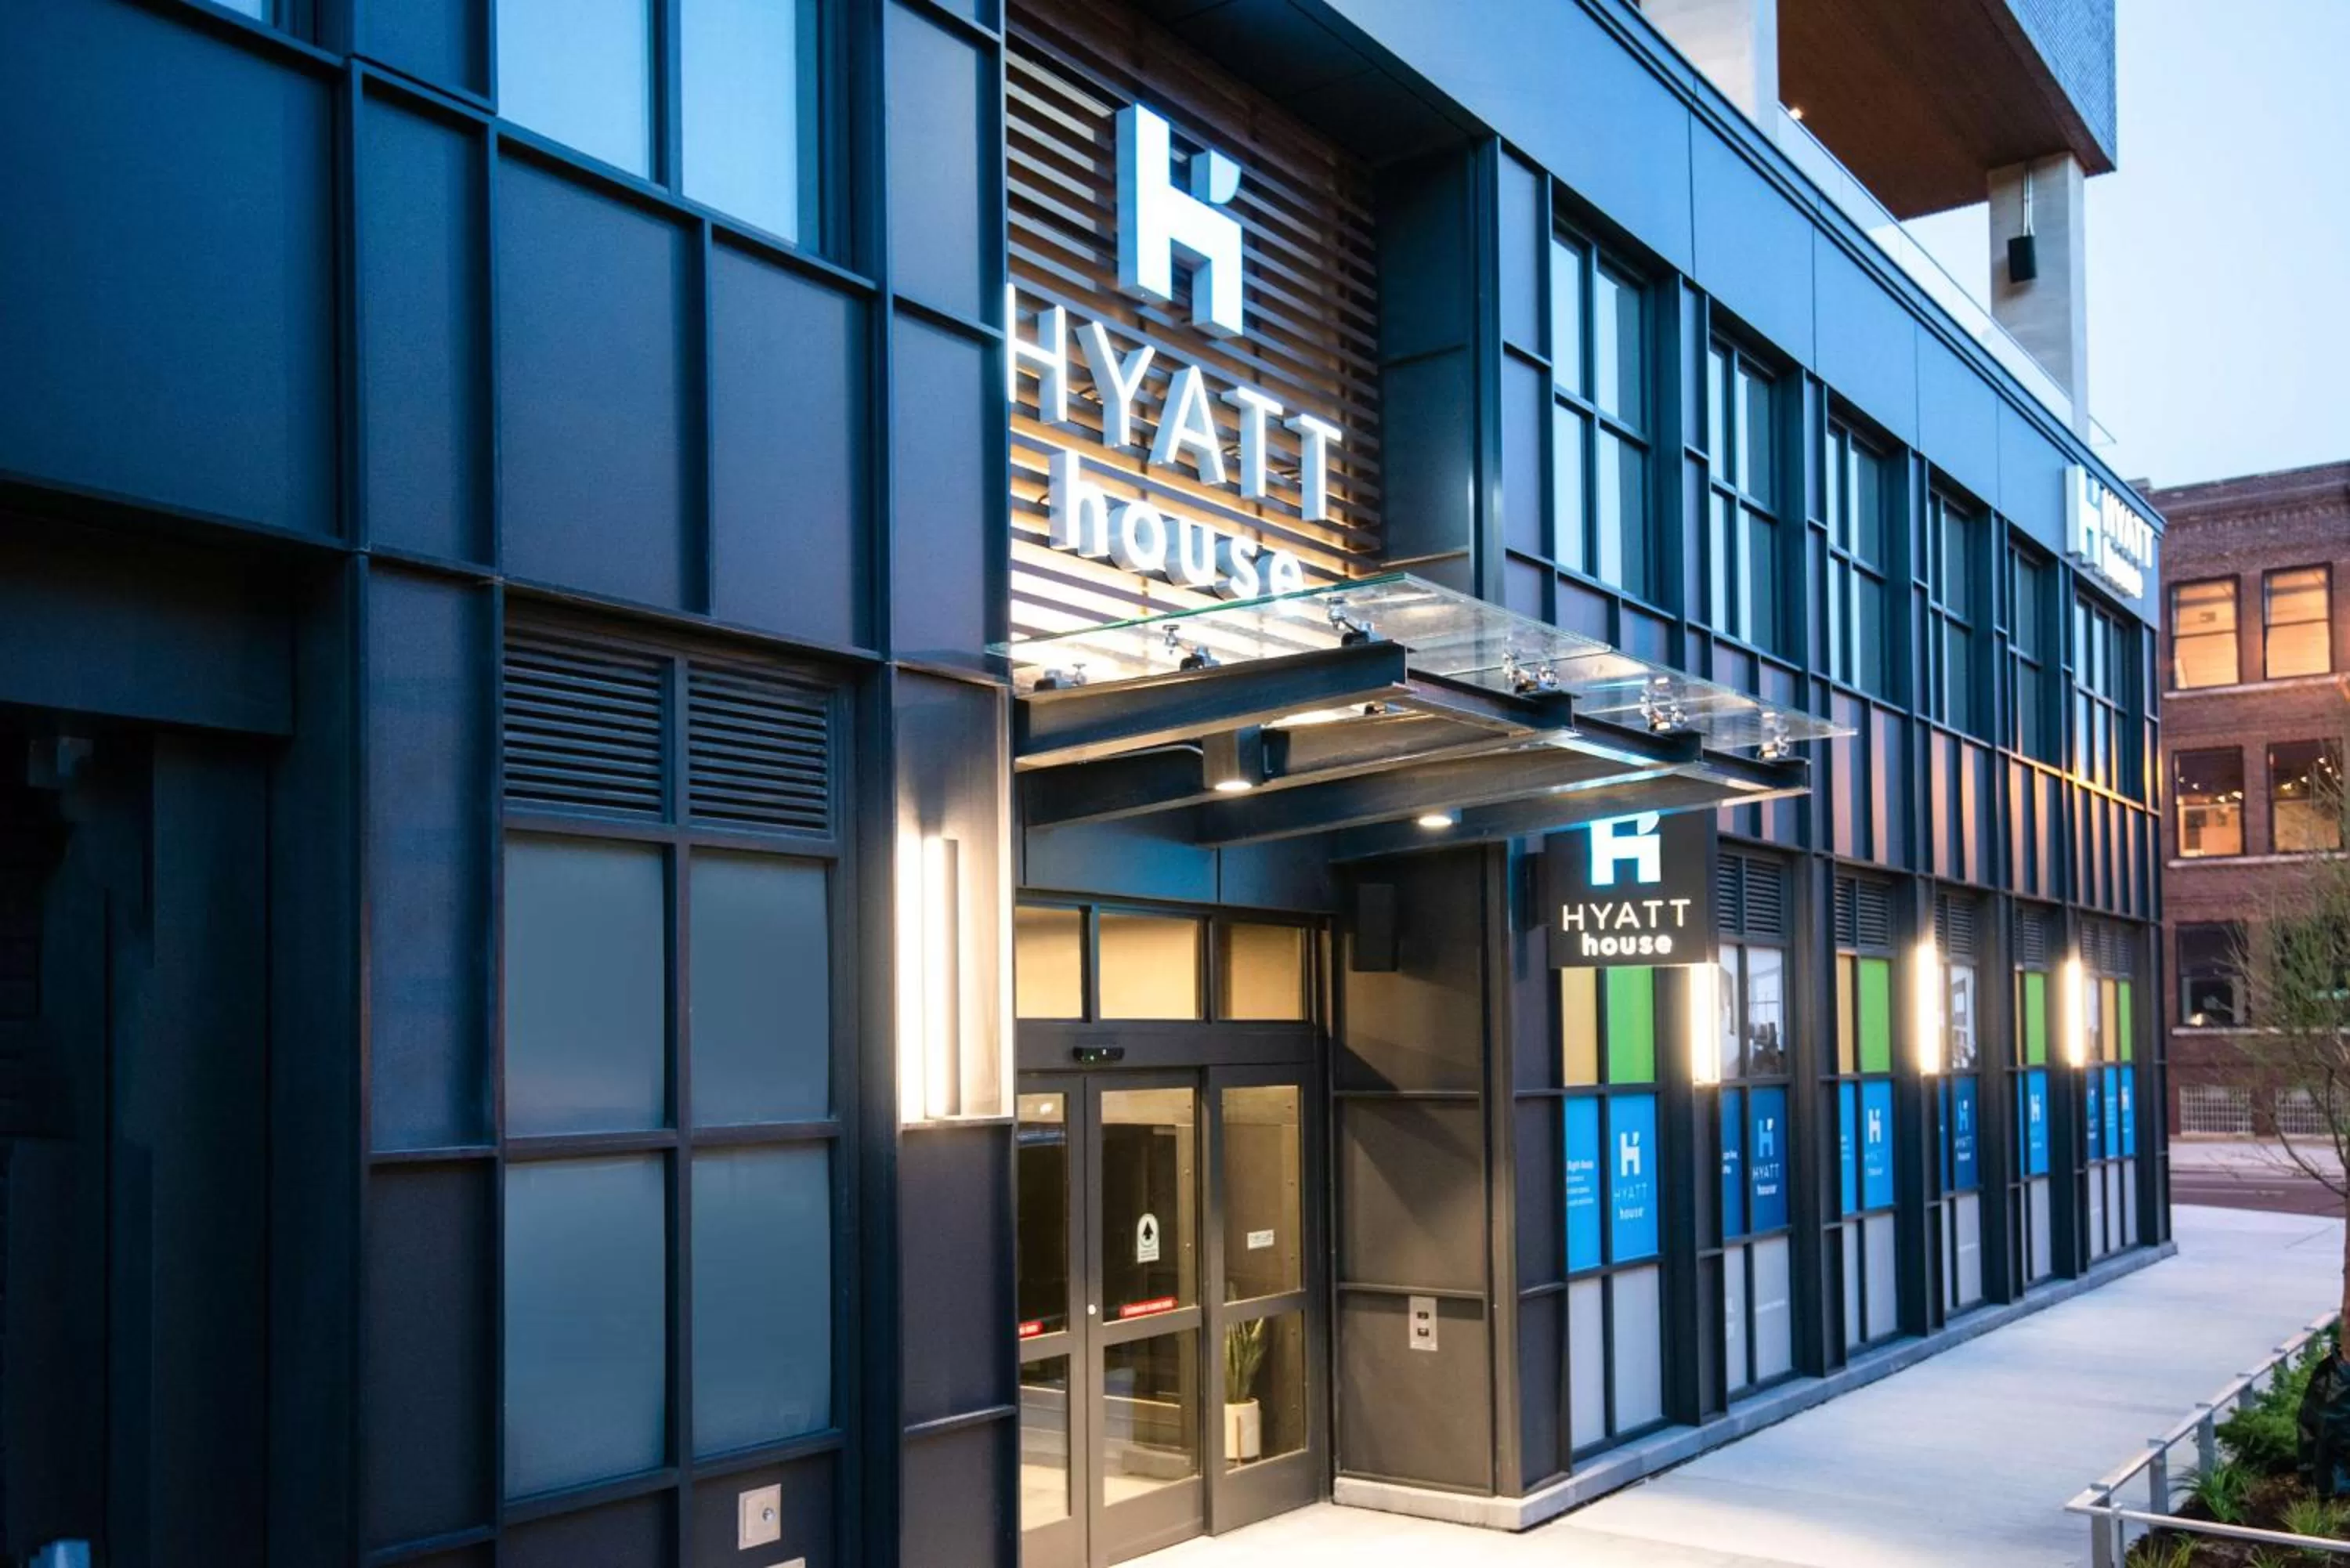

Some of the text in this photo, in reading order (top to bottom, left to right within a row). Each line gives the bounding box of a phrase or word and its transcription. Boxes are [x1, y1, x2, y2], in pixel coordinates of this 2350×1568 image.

[1006, 282, 1342, 522] HYATT
[1050, 449, 1305, 602] house
[1562, 898, 1691, 932] HYATT
[1582, 932, 1672, 956] house
